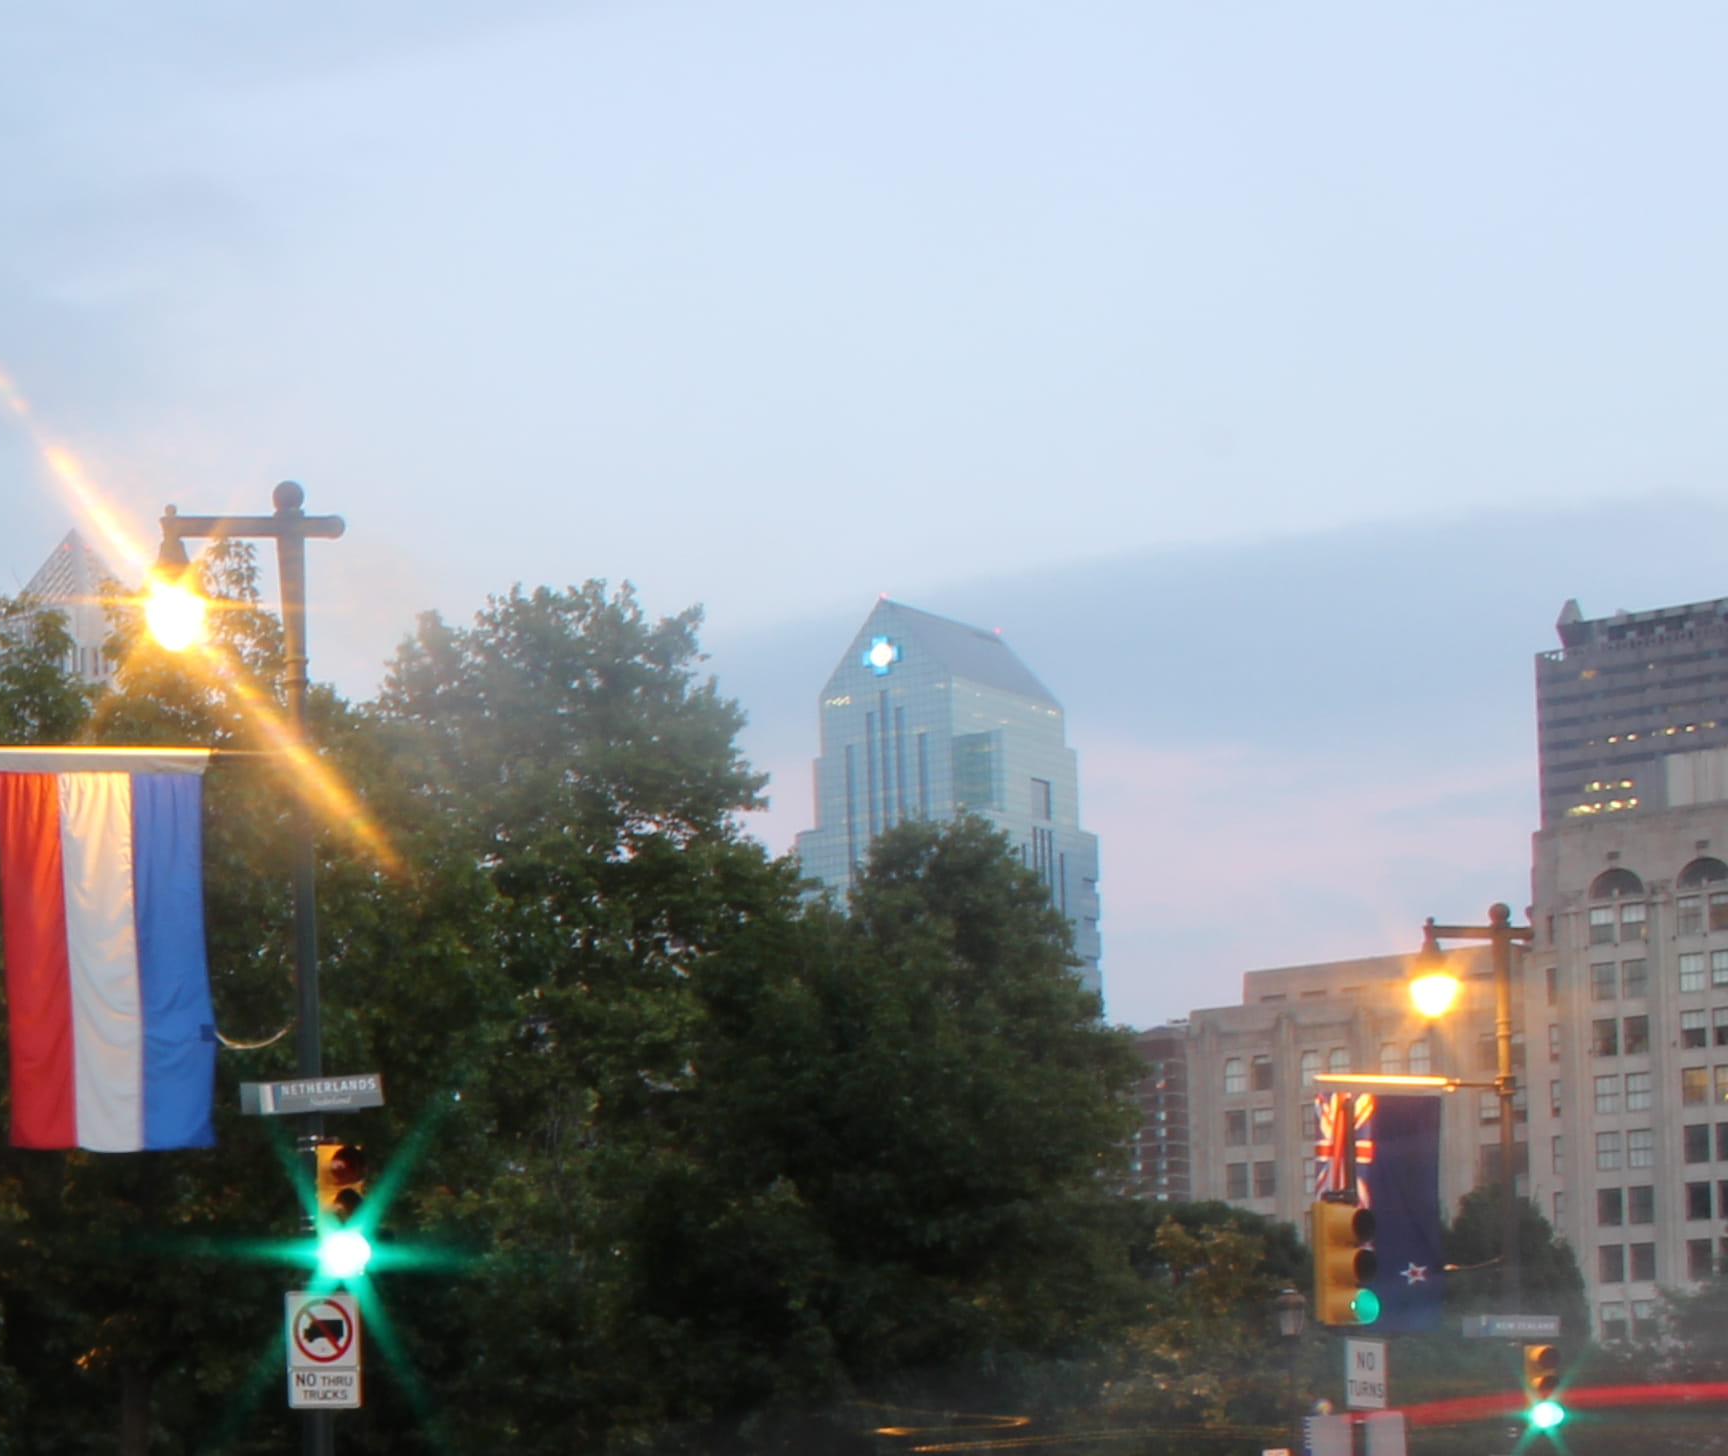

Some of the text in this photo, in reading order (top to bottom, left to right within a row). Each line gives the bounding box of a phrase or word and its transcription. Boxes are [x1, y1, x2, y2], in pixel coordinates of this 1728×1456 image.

[281, 1078, 377, 1096] NETHERLANDS
[1356, 1351, 1375, 1371] NO
[295, 1373, 354, 1387] NO THRU
[1348, 1379, 1385, 1399] TURNS
[303, 1390, 348, 1400] TRUCKS
